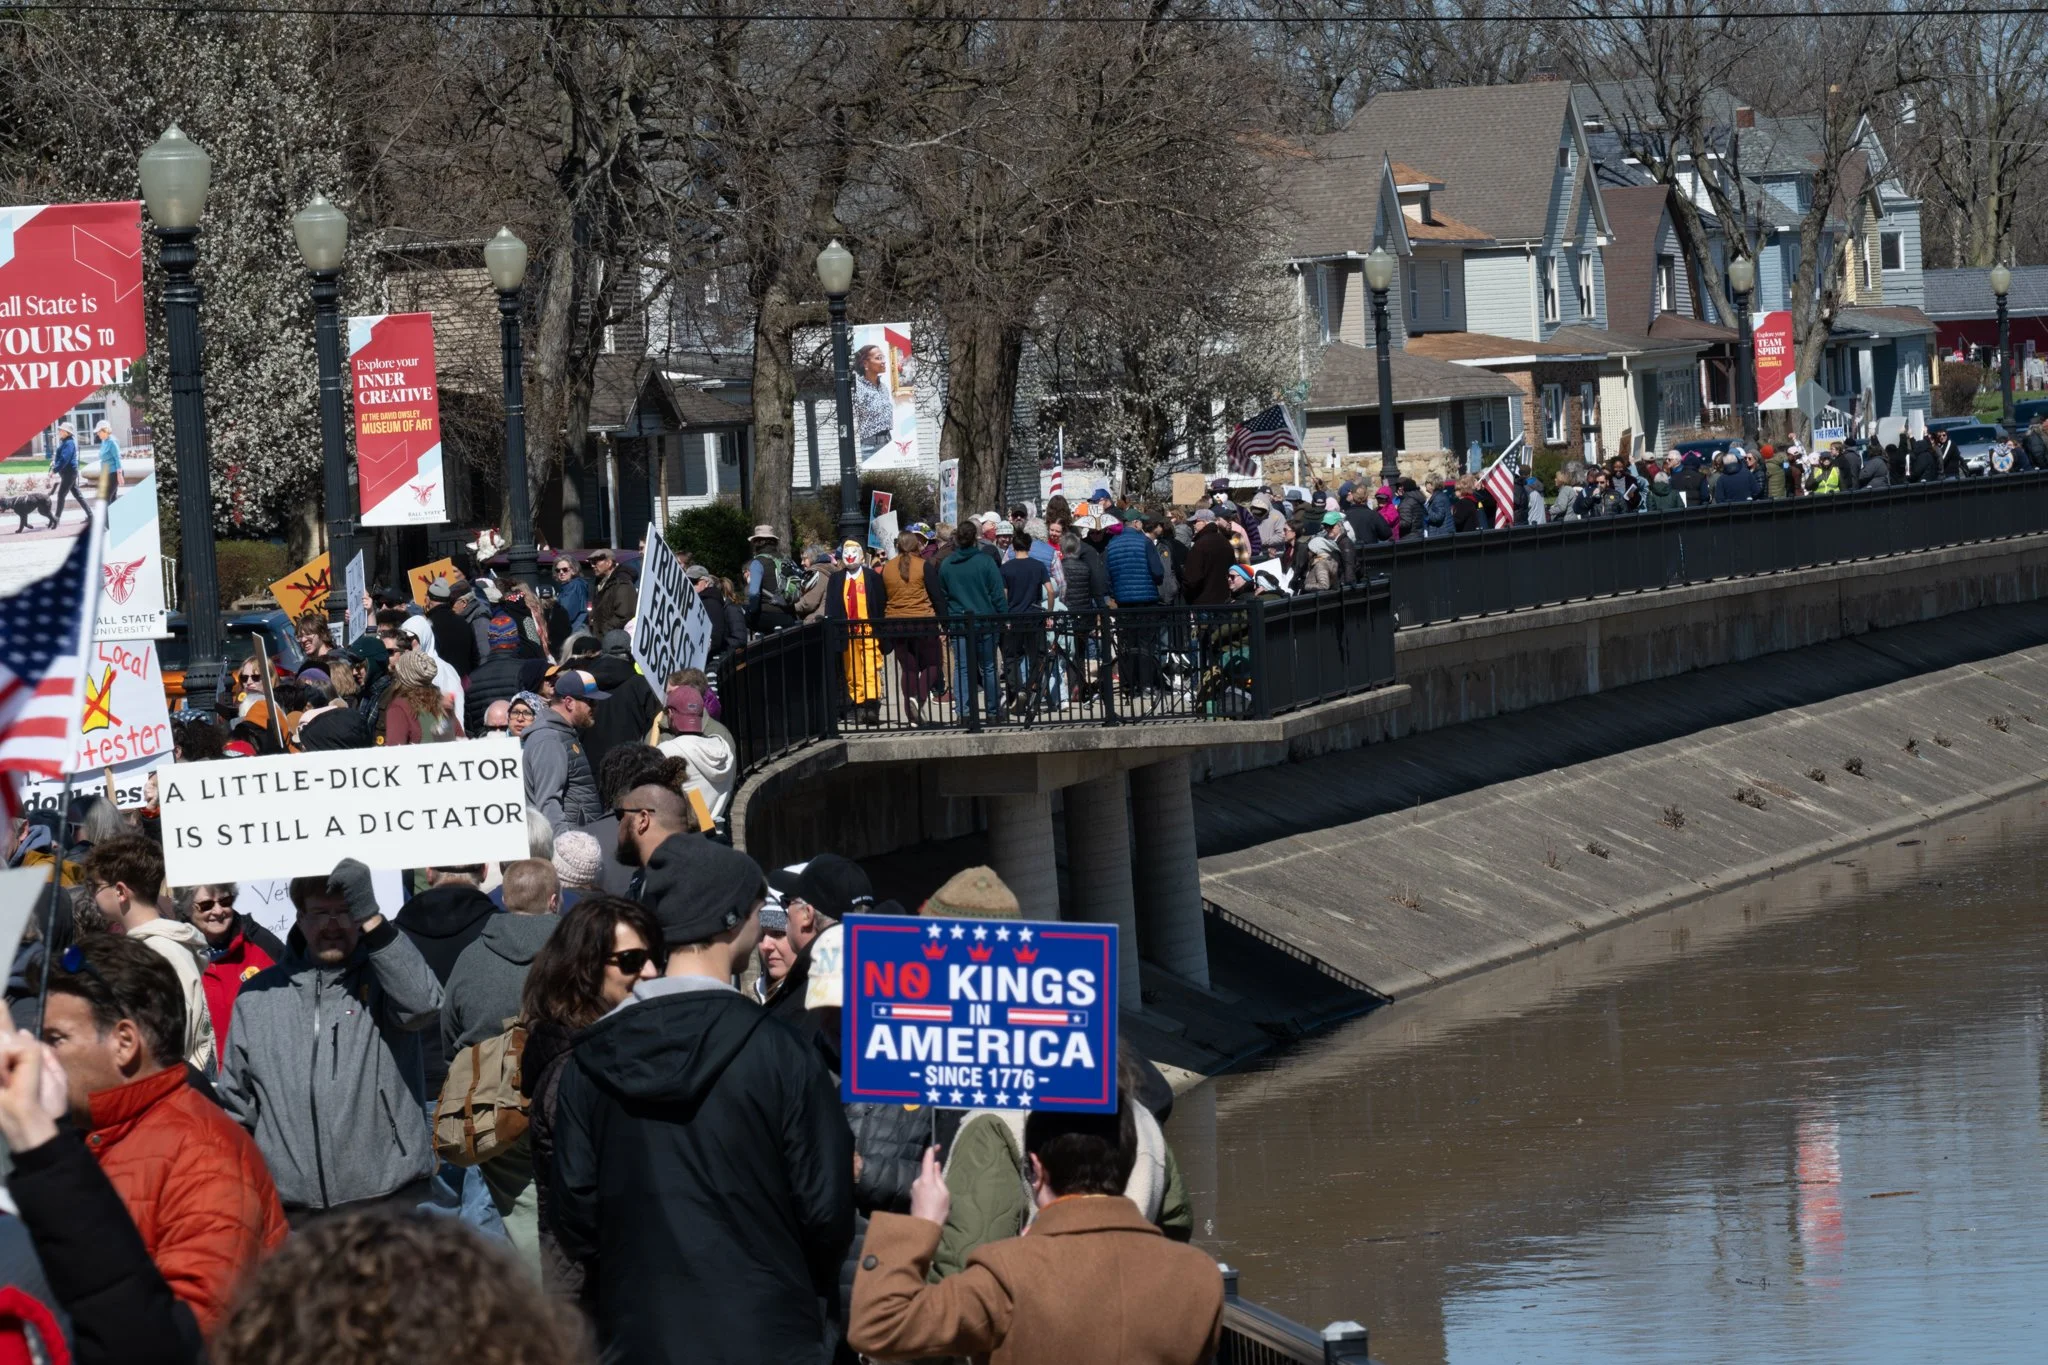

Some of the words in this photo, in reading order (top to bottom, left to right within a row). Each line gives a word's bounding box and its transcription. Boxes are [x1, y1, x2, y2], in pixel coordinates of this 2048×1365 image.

[0, 296, 21, 317] all
[26, 295, 77, 316] State
[81, 293, 97, 313] is
[97, 328, 115, 346] TO
[1757, 338, 1782, 347] TEAM
[1757, 346, 1786, 356] SPIRIT
[357, 358, 395, 372] Explore
[396, 358, 419, 370] your
[358, 372, 405, 388] INNER
[359, 387, 433, 405] CREATIVE
[361, 413, 368, 422] AT
[369, 412, 379, 421] THE
[380, 411, 397, 420] DAVID
[397, 410, 420, 419] OWSLEY
[362, 420, 401, 434] MUSEUM
[402, 420, 414, 432] OF
[415, 418, 433, 431] ART
[1815, 430, 1824, 439] THE
[1825, 428, 1843, 438] FRENCH
[651, 531, 694, 622] TRUMP
[93, 625, 152, 636] UNIVERSITY
[95, 616, 117, 625] ALL
[121, 613, 156, 624] STATE
[650, 582, 695, 670] FASCIST
[98, 641, 150, 680] Local
[638, 615, 675, 692] DISGR
[76, 723, 166, 771] tester
[164, 782, 186, 804] A
[200, 765, 401, 800] LITTLE-DICK
[418, 758, 520, 784] TATOR
[175, 826, 203, 848] IS
[217, 818, 309, 846] STILL
[325, 816, 345, 837] A
[360, 802, 524, 835] DICTATOR
[251, 881, 289, 905] Vet
[863, 961, 931, 998] NO
[949, 964, 1096, 1006] KINGS
[969, 1004, 991, 1026] IN
[864, 1024, 1096, 1068] AMERICA
[925, 1066, 983, 1087] SINCE
[988, 1069, 1035, 1090] 1776
